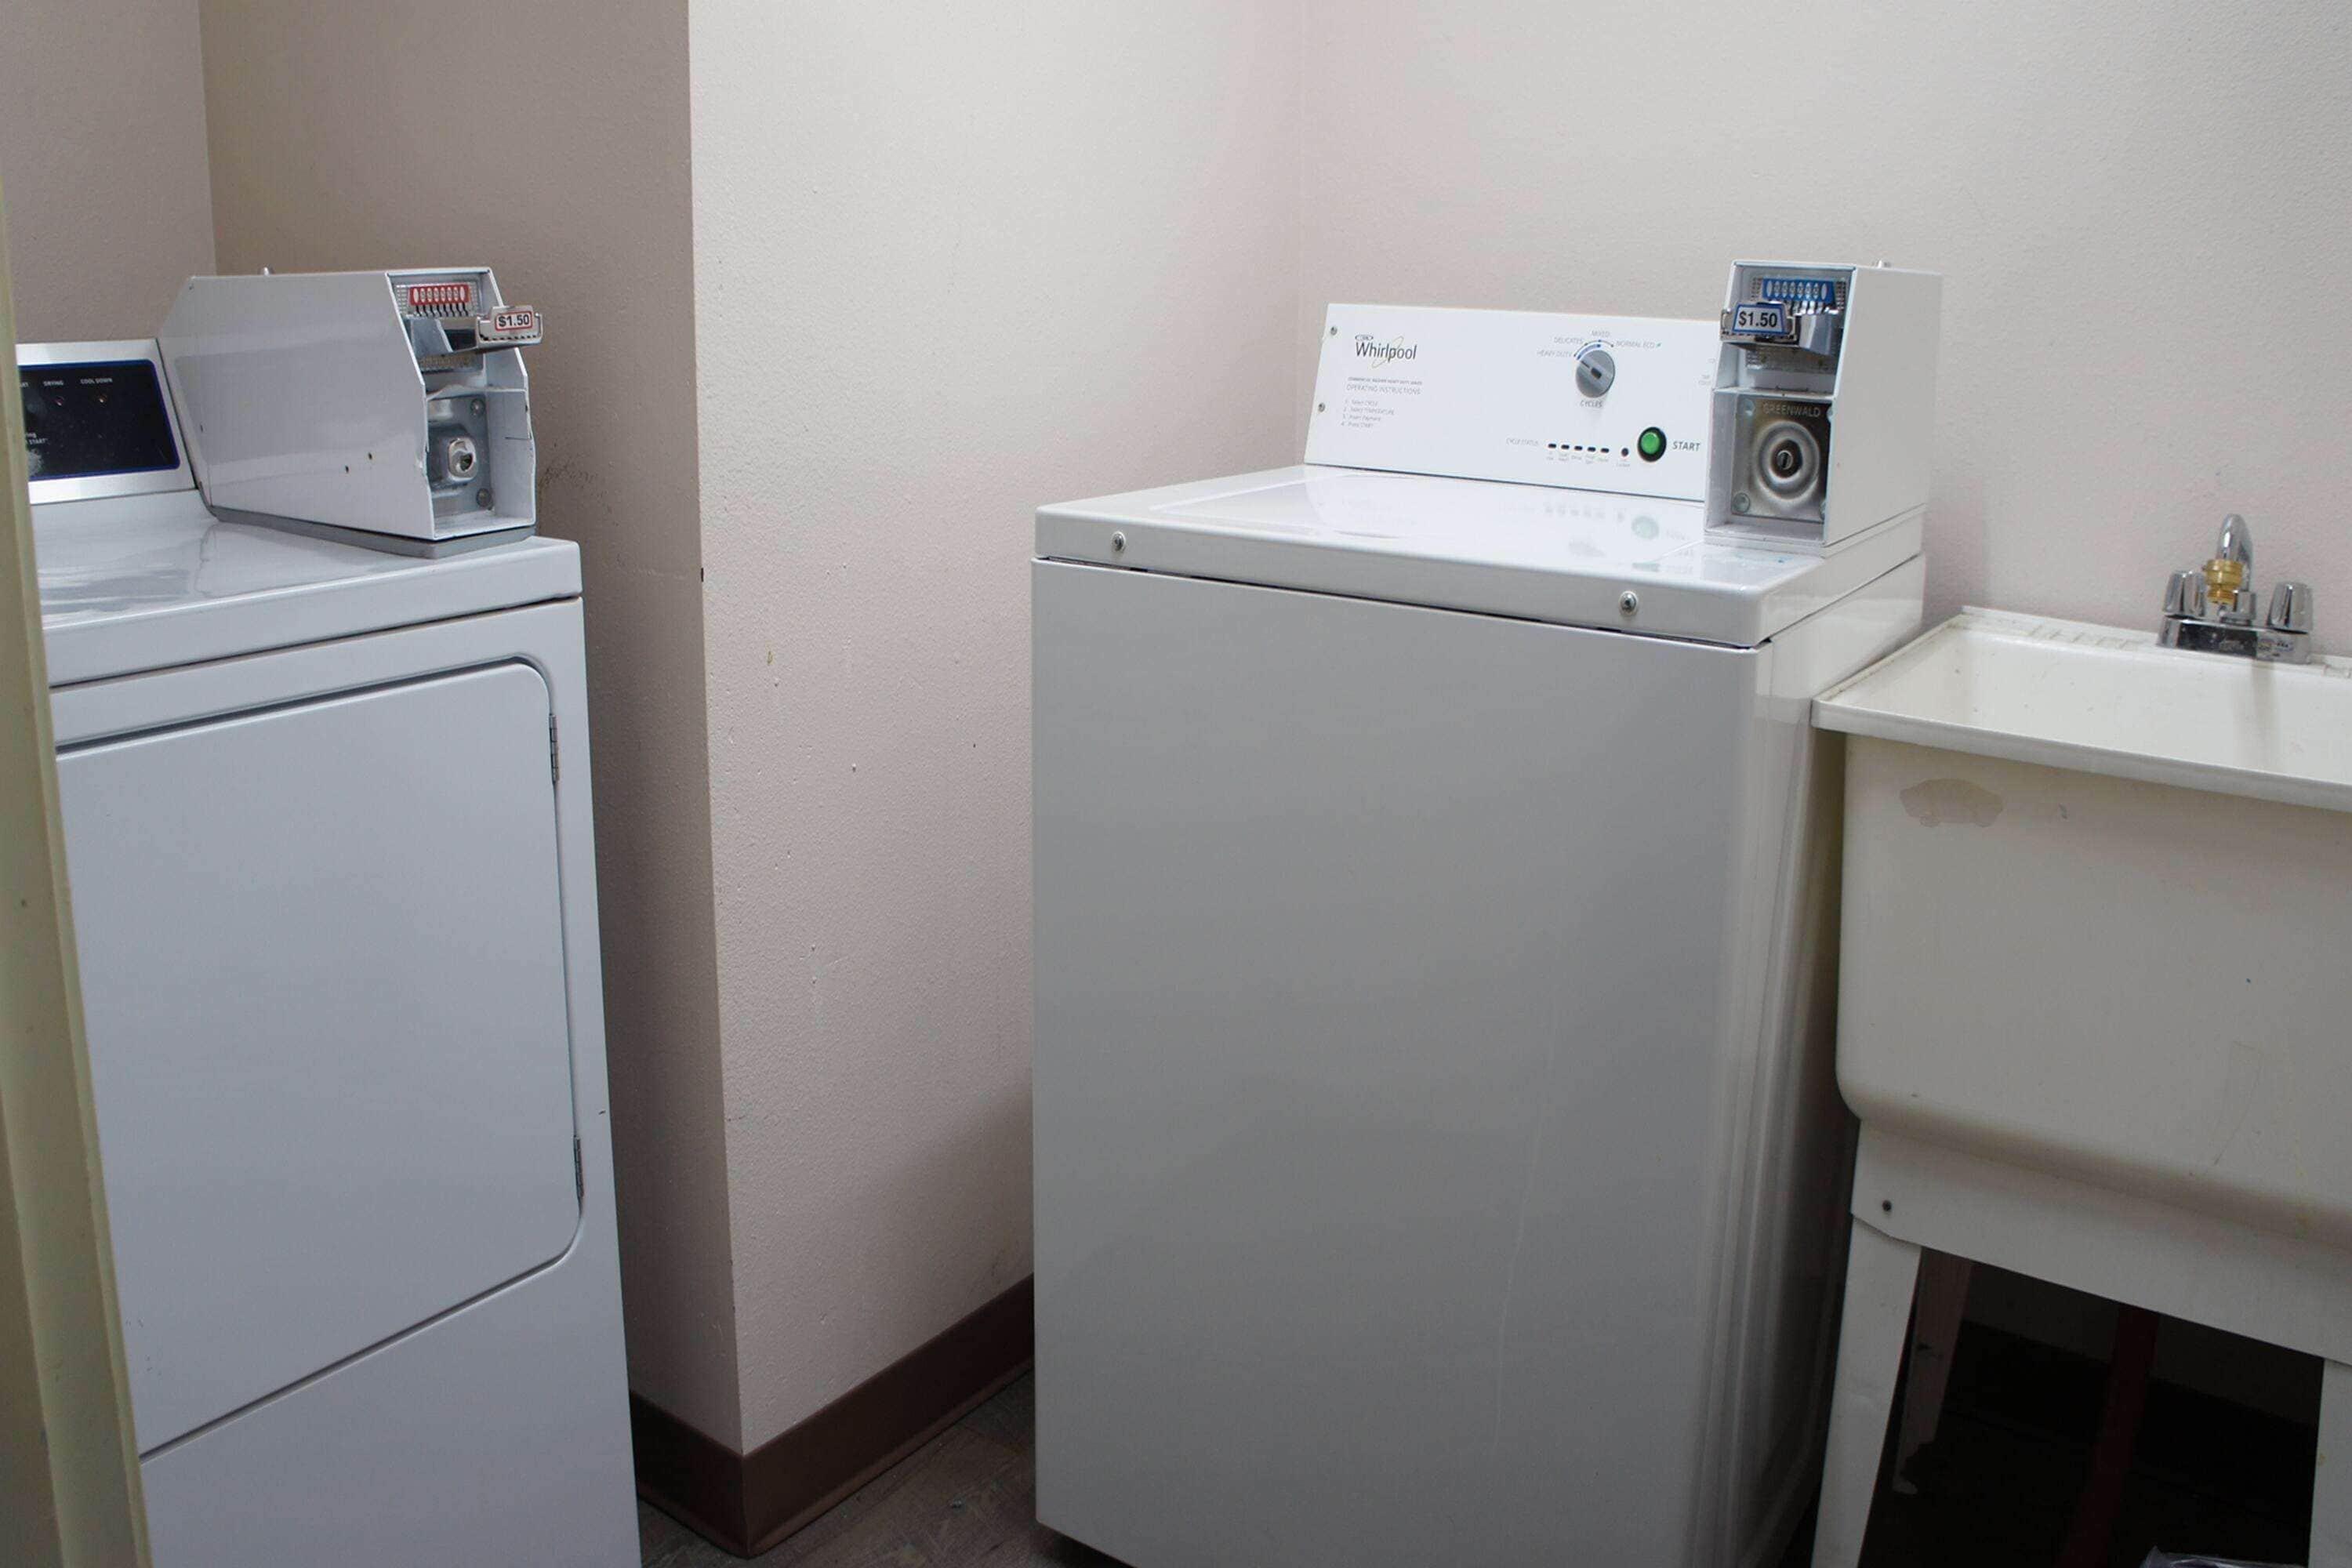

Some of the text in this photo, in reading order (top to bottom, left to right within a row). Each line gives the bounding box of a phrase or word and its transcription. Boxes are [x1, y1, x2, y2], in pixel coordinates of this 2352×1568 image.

[498, 314, 530, 328] $1.50
[1738, 310, 1778, 328] $1.50
[1356, 341, 1417, 363] Whirlpool
[1763, 402, 1820, 418] GREENWALD
[1672, 441, 1701, 452] START
